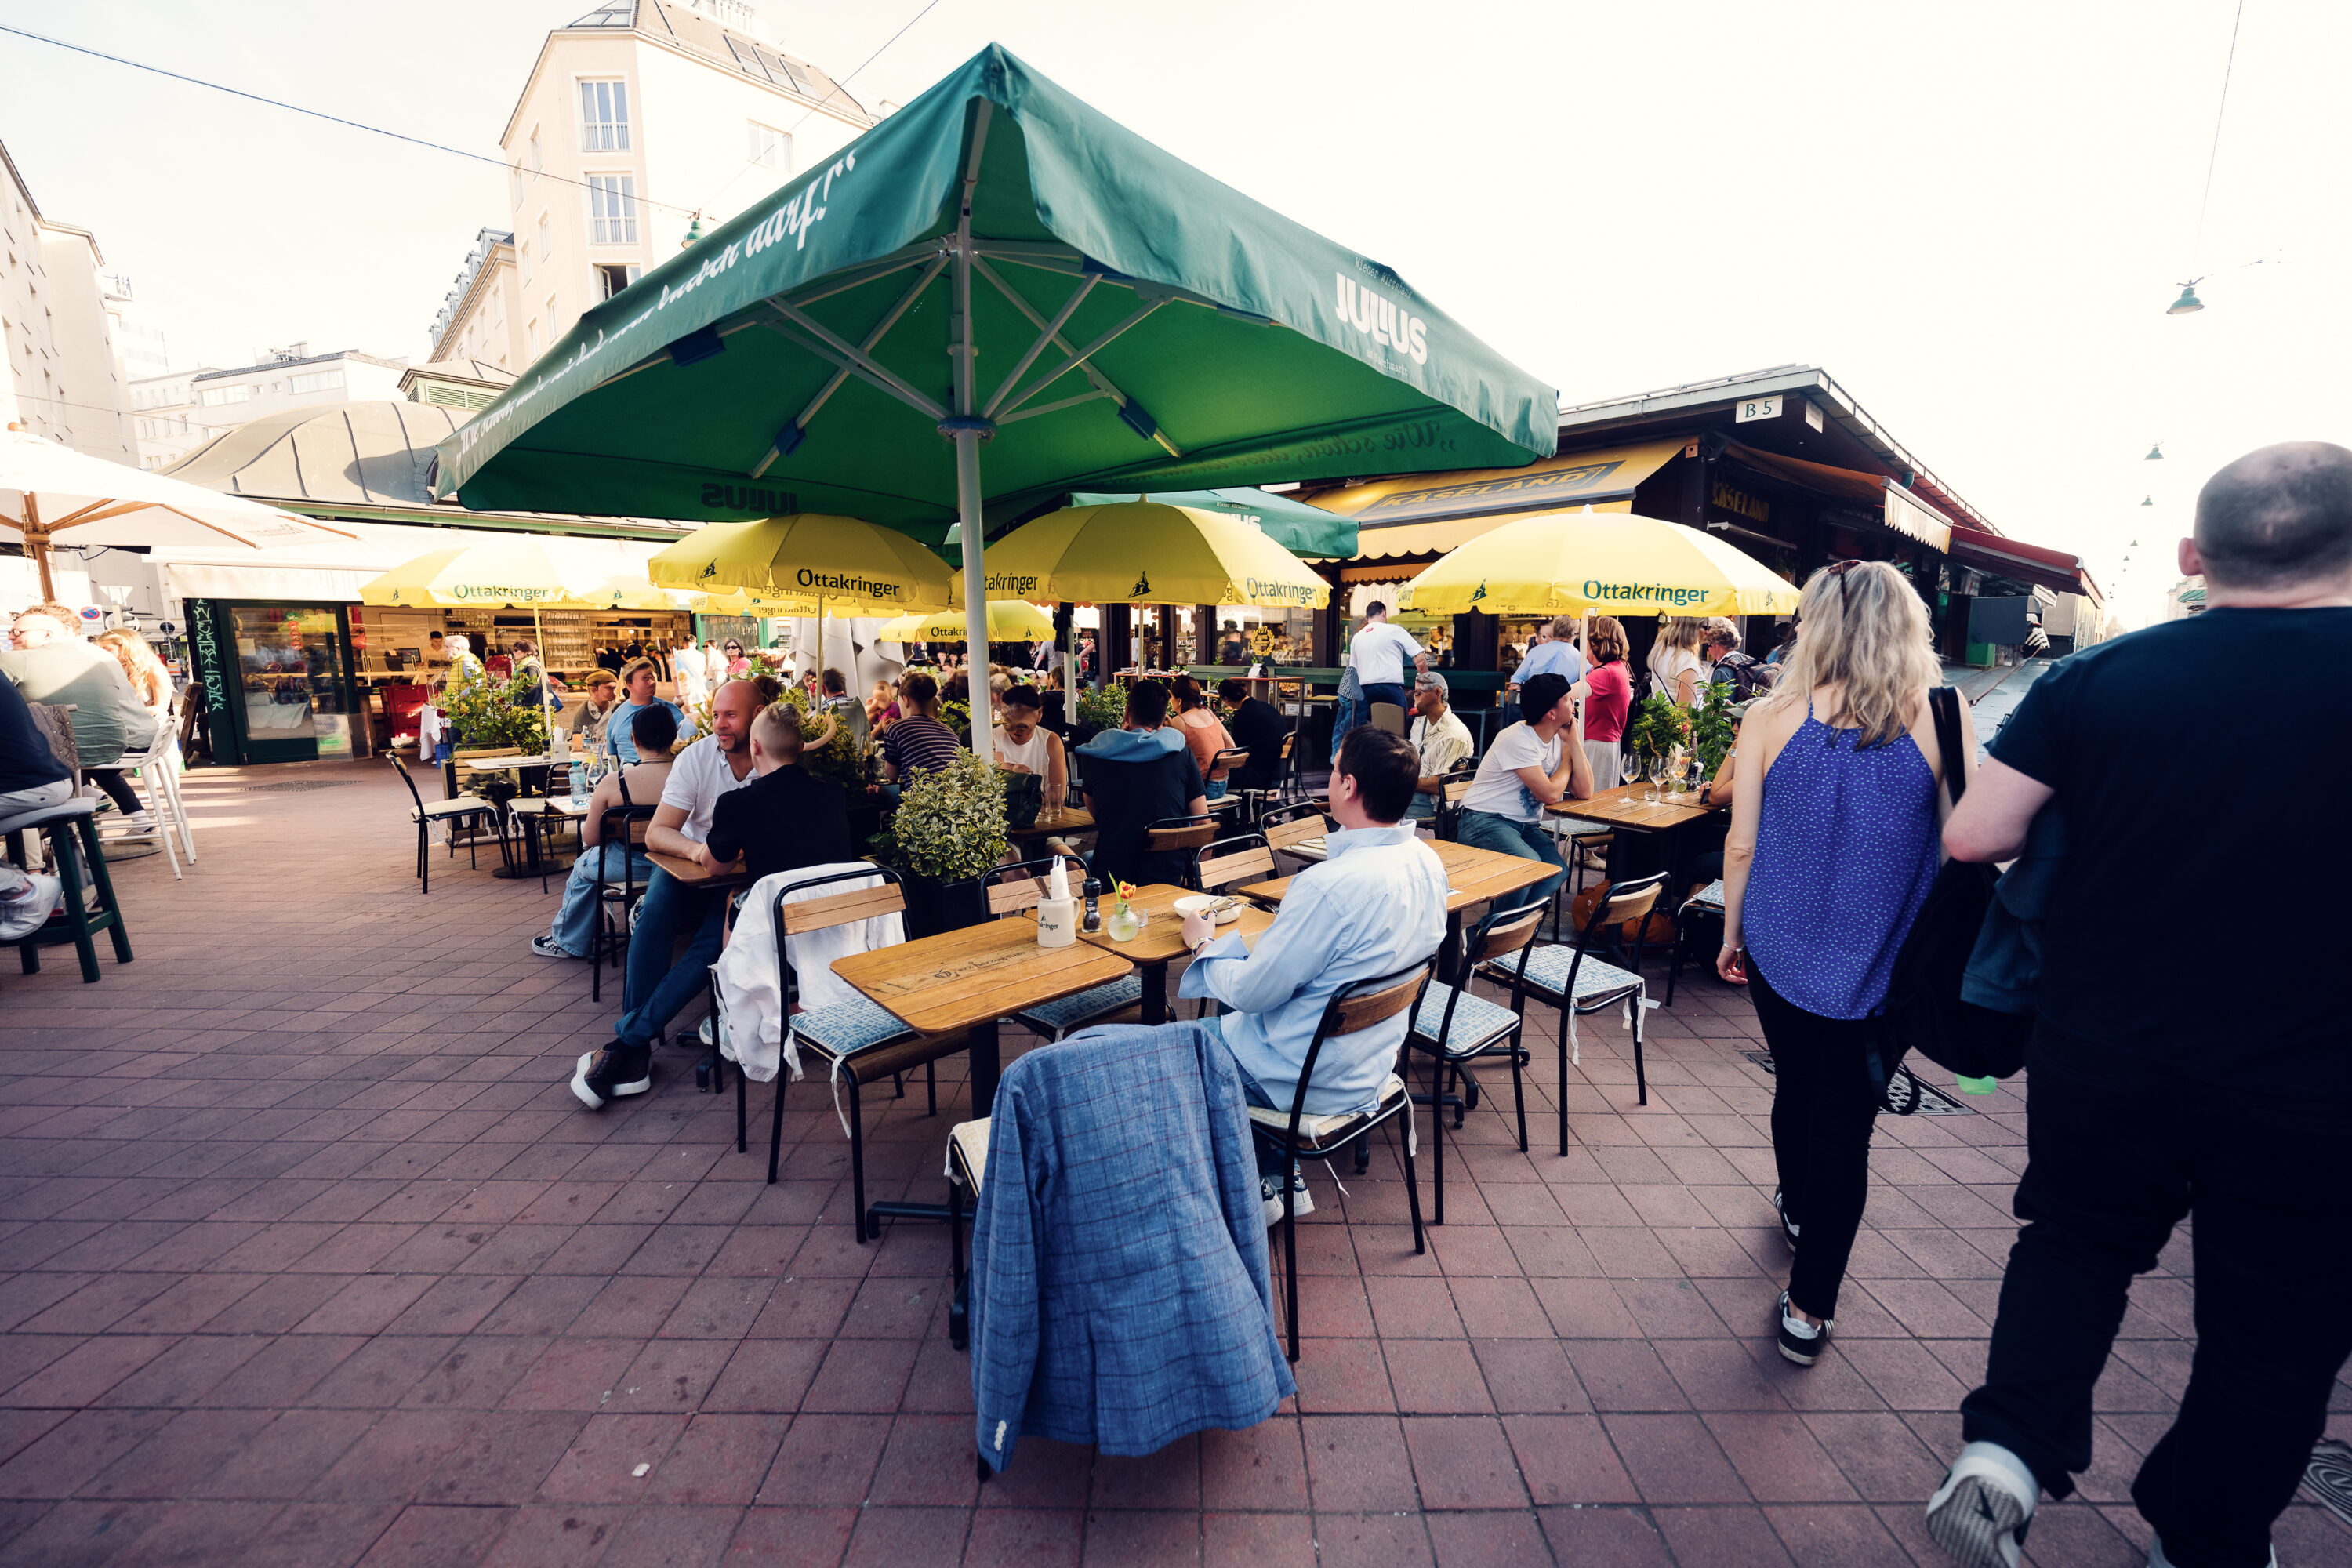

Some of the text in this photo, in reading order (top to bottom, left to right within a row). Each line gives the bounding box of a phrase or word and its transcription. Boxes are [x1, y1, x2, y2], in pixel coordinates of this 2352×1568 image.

[1354, 256, 1414, 300] Wiener Wirtshaus
[1335, 271, 1427, 365] JULIUS
[1745, 400, 1773, 418] B 5
[1378, 470, 1588, 508] KÄSELAND
[454, 584, 549, 601] Ottakringer
[797, 568, 900, 597] Ottakringer
[985, 572, 1038, 595] takringer
[1247, 576, 1317, 604] Ottakringer
[1583, 579, 1710, 607] Ottakringer
[931, 626, 967, 637] Ottakri
